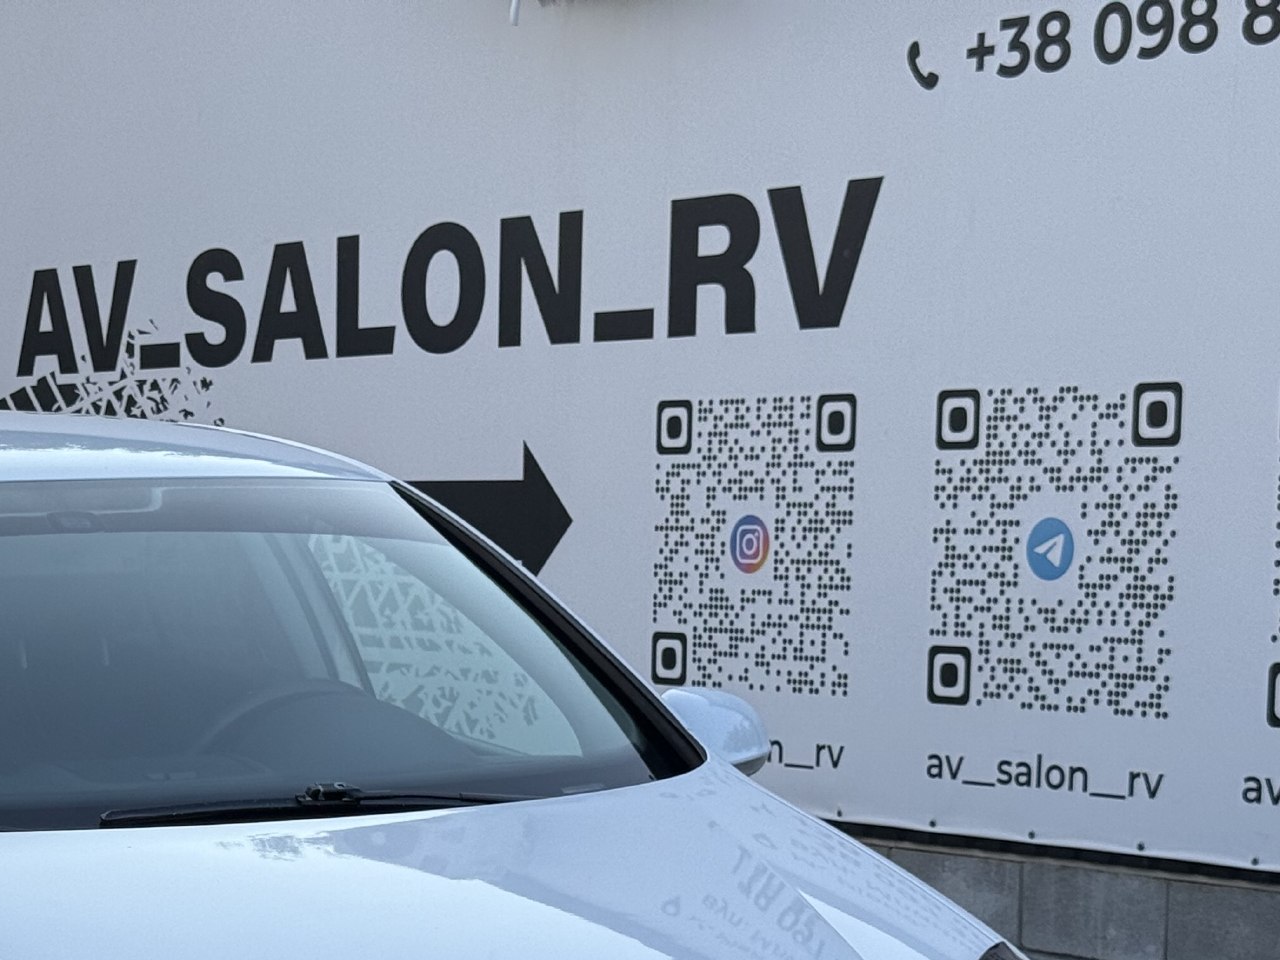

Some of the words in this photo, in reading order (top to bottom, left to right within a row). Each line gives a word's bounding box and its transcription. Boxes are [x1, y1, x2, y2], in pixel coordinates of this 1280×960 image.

[966, 10, 1071, 79] +38
[1093, 0, 1219, 66] 098
[1241, 0, 1280, 47] 8
[17, 176, 884, 377] AV_SALON_RV
